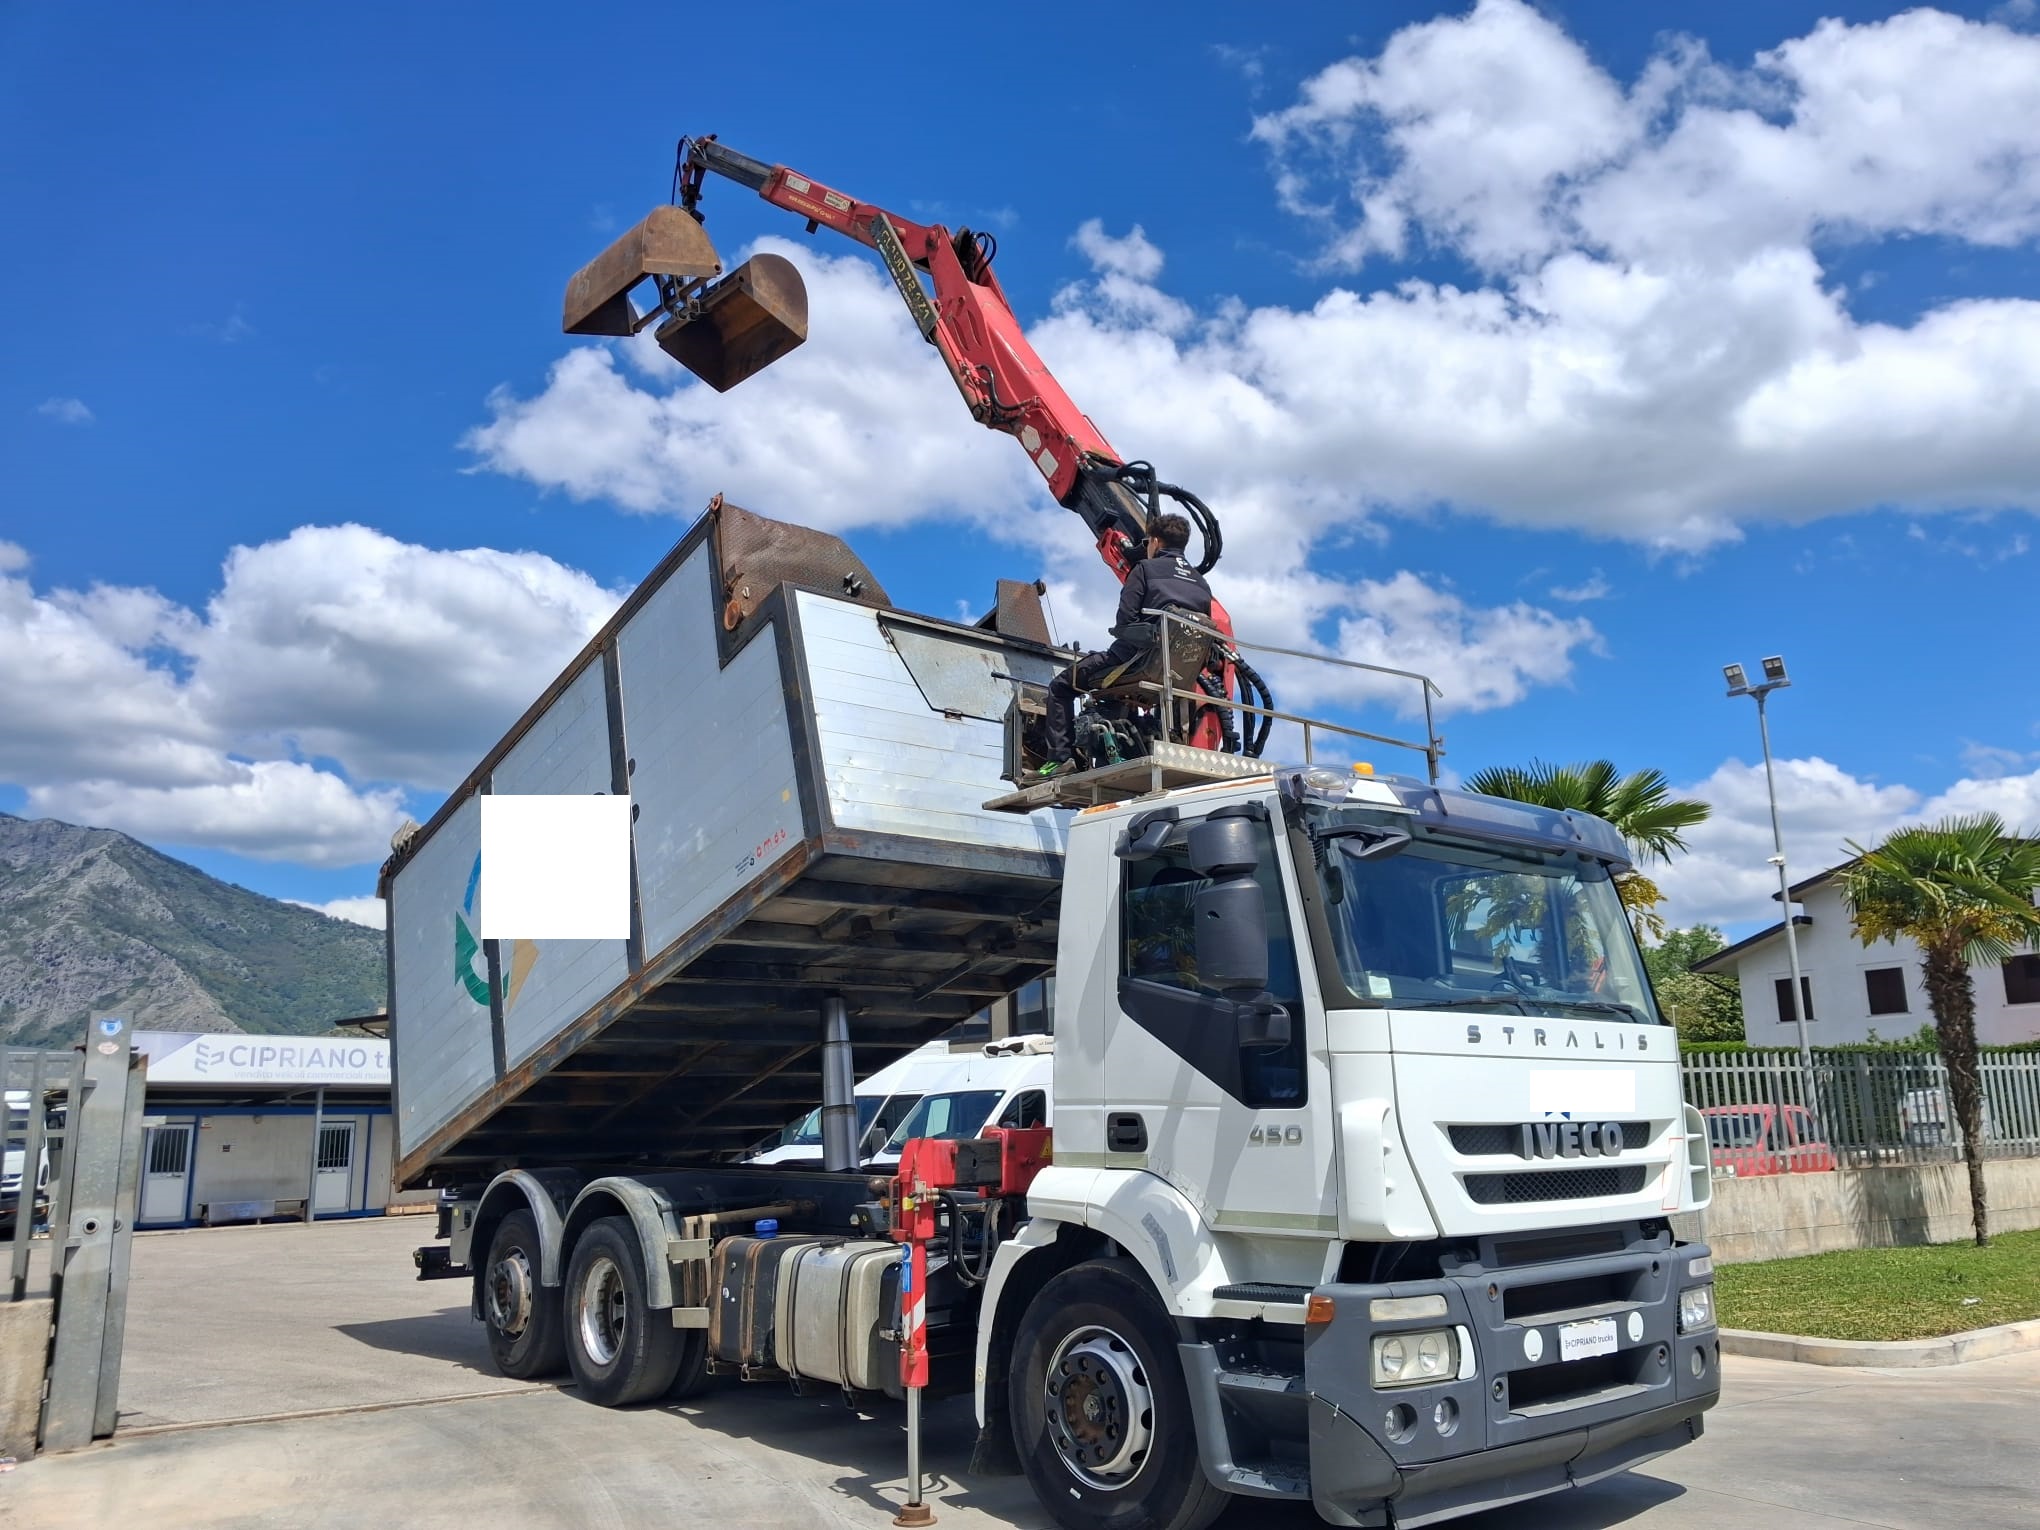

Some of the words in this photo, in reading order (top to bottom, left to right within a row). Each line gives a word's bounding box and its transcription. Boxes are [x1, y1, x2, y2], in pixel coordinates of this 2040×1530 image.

[1467, 1024, 1648, 1051] STRALIS
[229, 1045, 367, 1069] CIPRIANO
[1248, 1125, 1303, 1145] 450
[1521, 1122, 1624, 1161] IVECO
[1571, 1336, 1597, 1348] CIPRIANO
[1597, 1334, 1614, 1344] trucks
